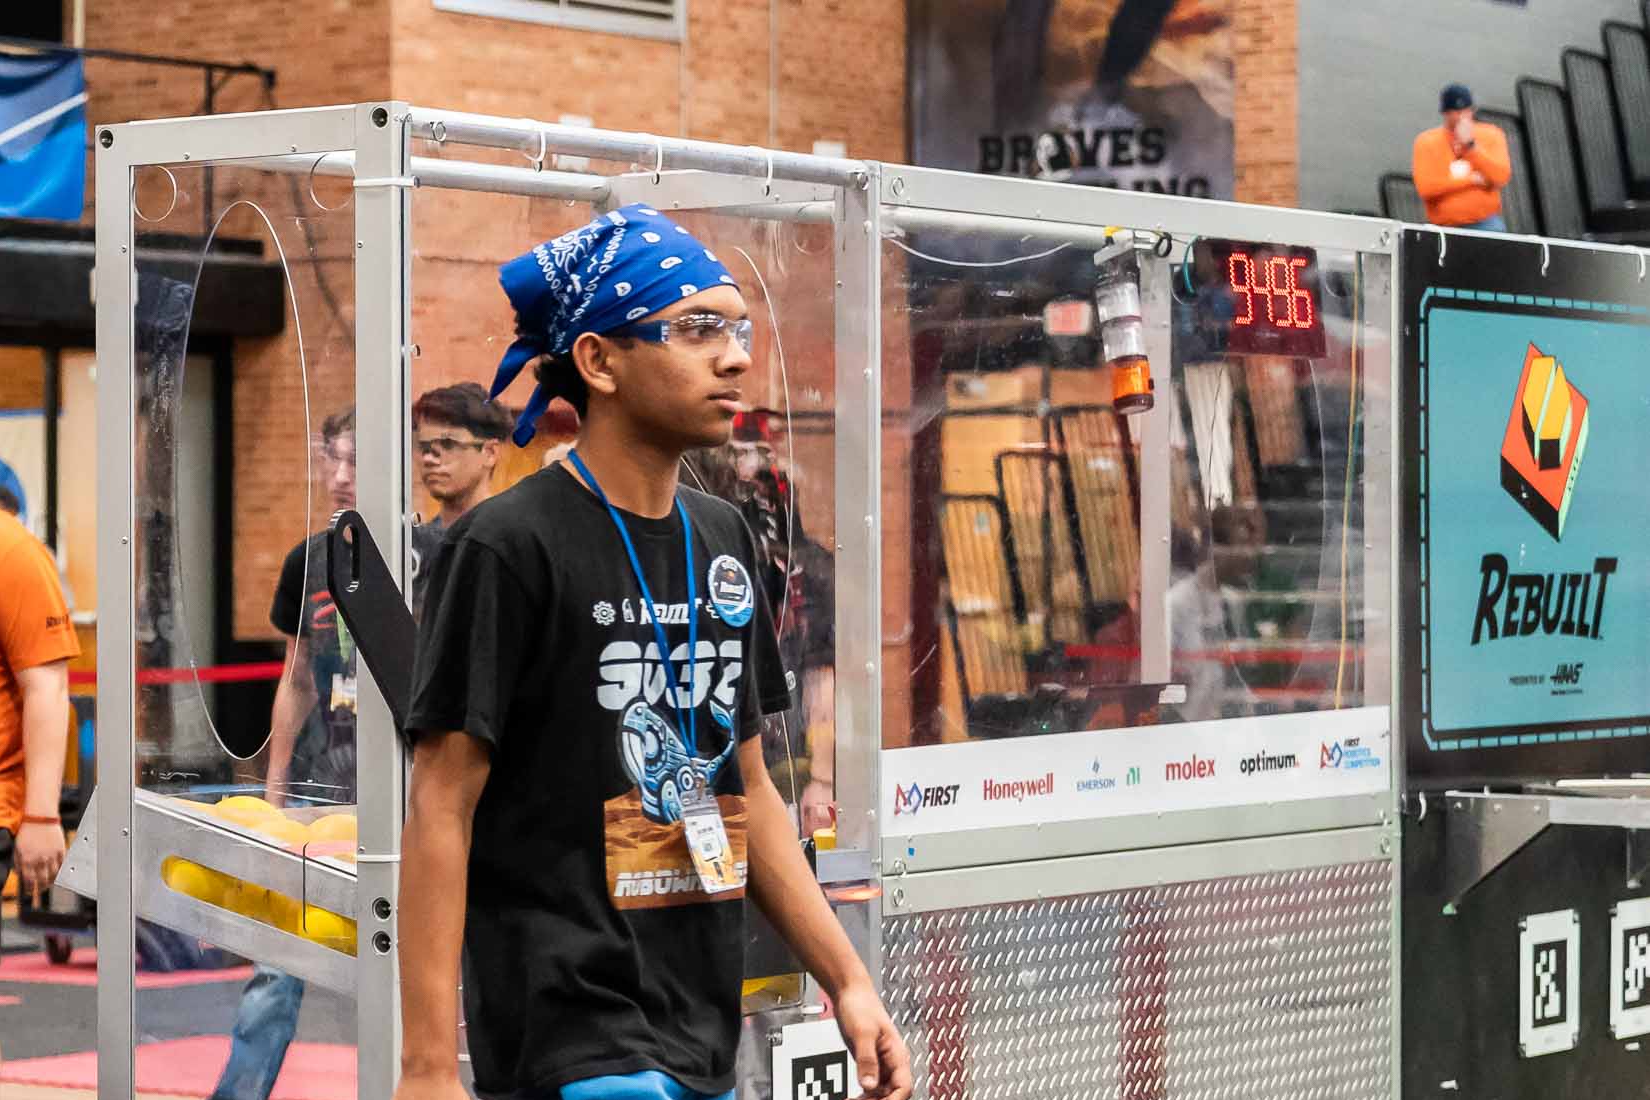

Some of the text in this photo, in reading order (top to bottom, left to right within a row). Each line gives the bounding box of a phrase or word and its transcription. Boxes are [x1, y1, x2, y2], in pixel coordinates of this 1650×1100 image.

[979, 128, 1165, 174] BRAVES
[1228, 252, 1313, 328] 9496
[1470, 553, 1618, 646] REBUILT
[1165, 754, 1215, 781] molex
[922, 784, 960, 808] FIRST
[983, 772, 1054, 802] Honeywell
[1076, 777, 1116, 792] EMERSON
